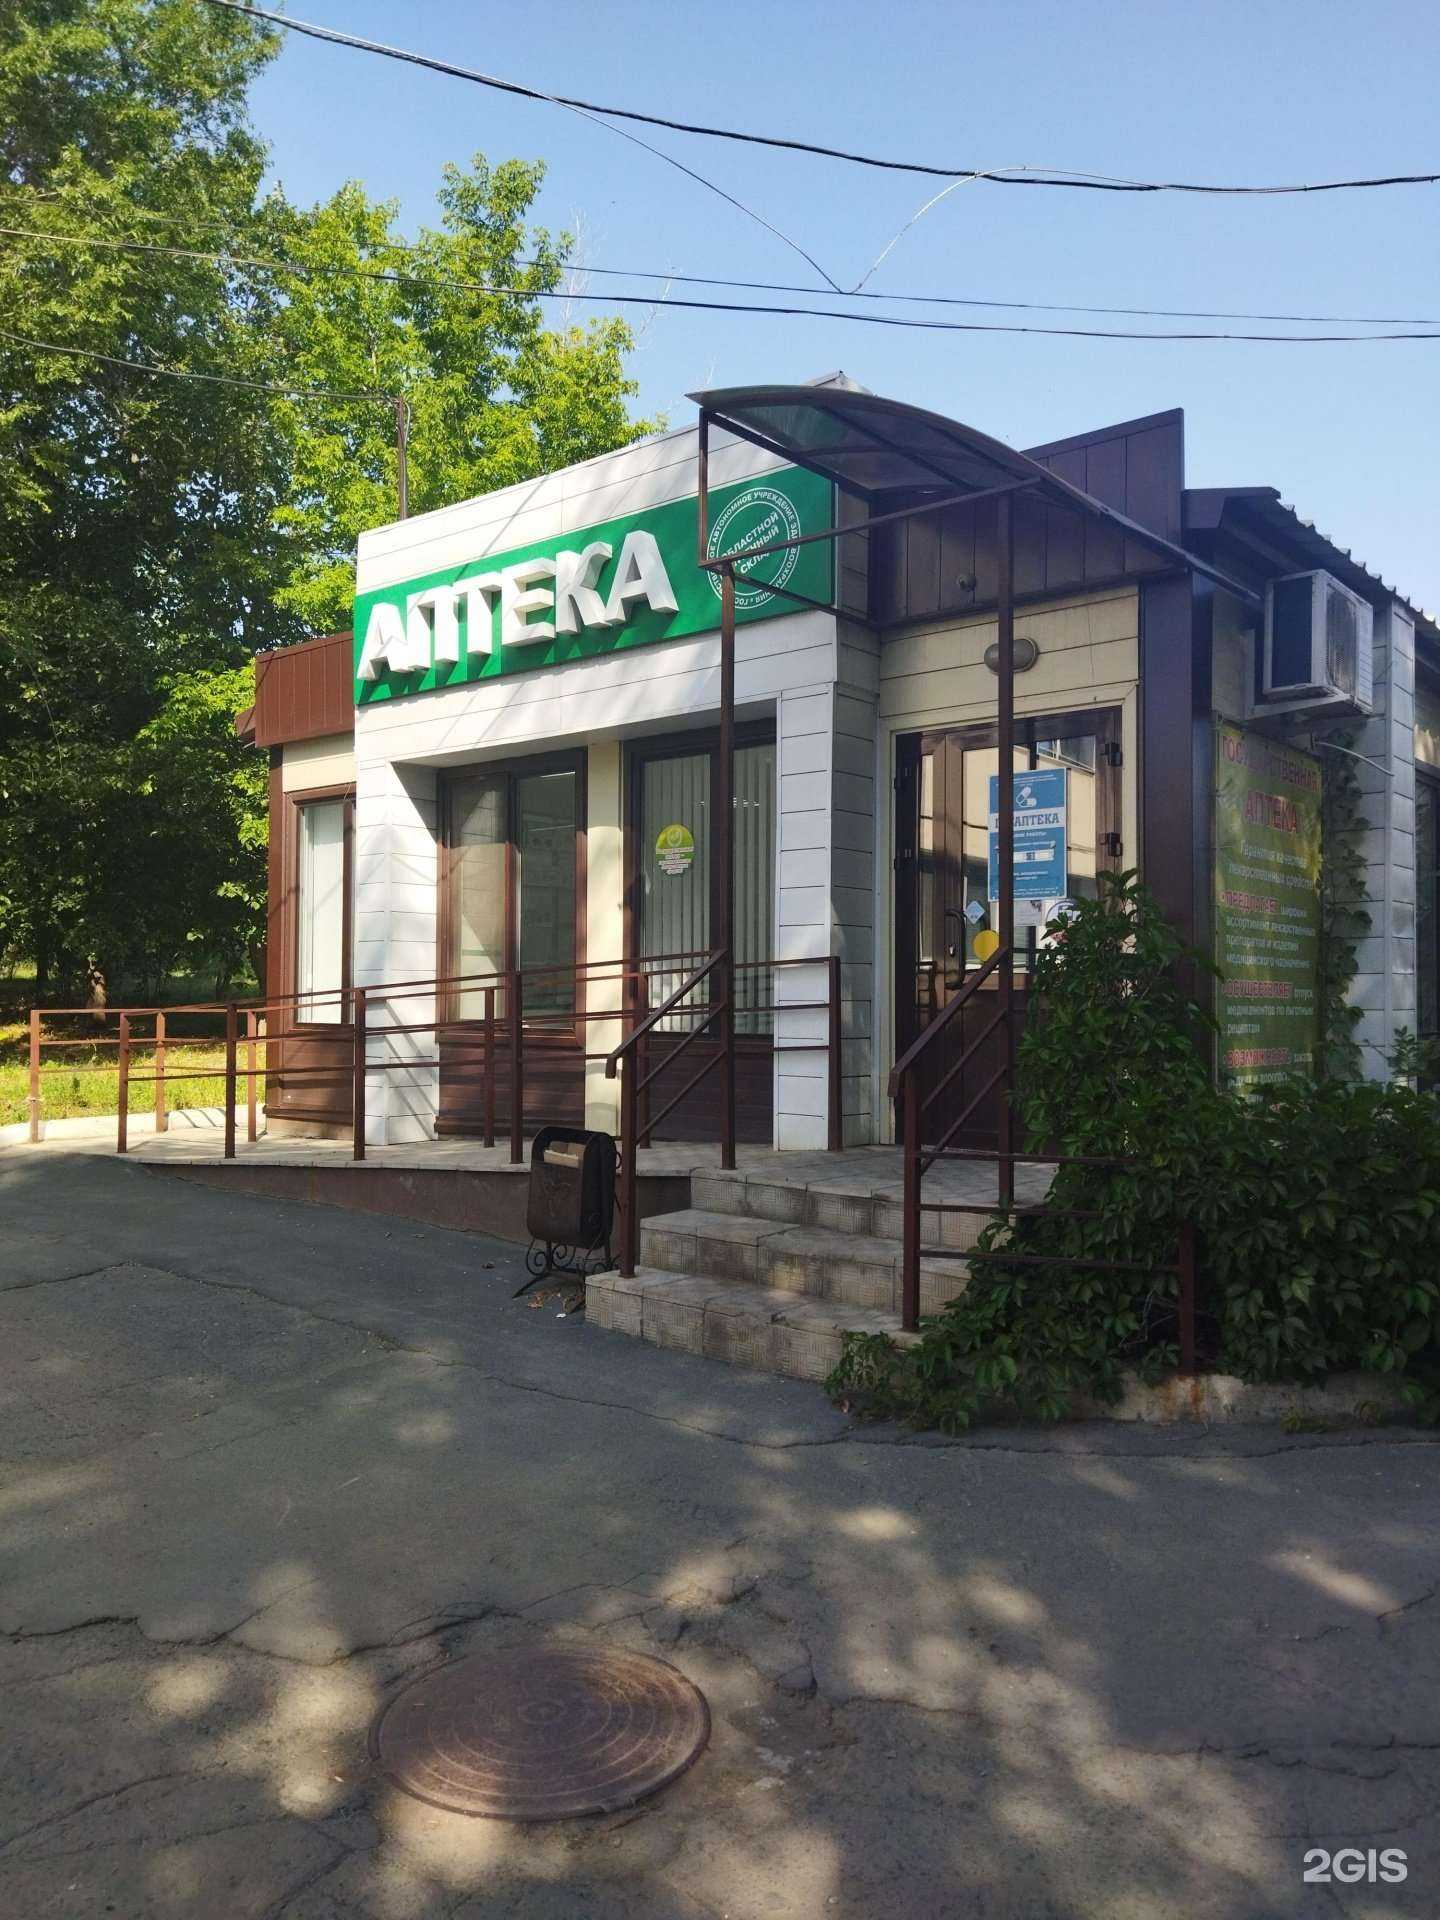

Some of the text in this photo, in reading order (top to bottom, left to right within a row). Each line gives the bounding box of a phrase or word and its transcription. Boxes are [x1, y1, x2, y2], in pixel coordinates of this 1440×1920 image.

[713, 492, 753, 543] АВТОНОМНОЕ
[752, 490, 795, 524] УЧРЕЖДЕНИЕ
[357, 530, 679, 681] АПТЕКА
[1243, 791, 1299, 832] АПТЕКА
